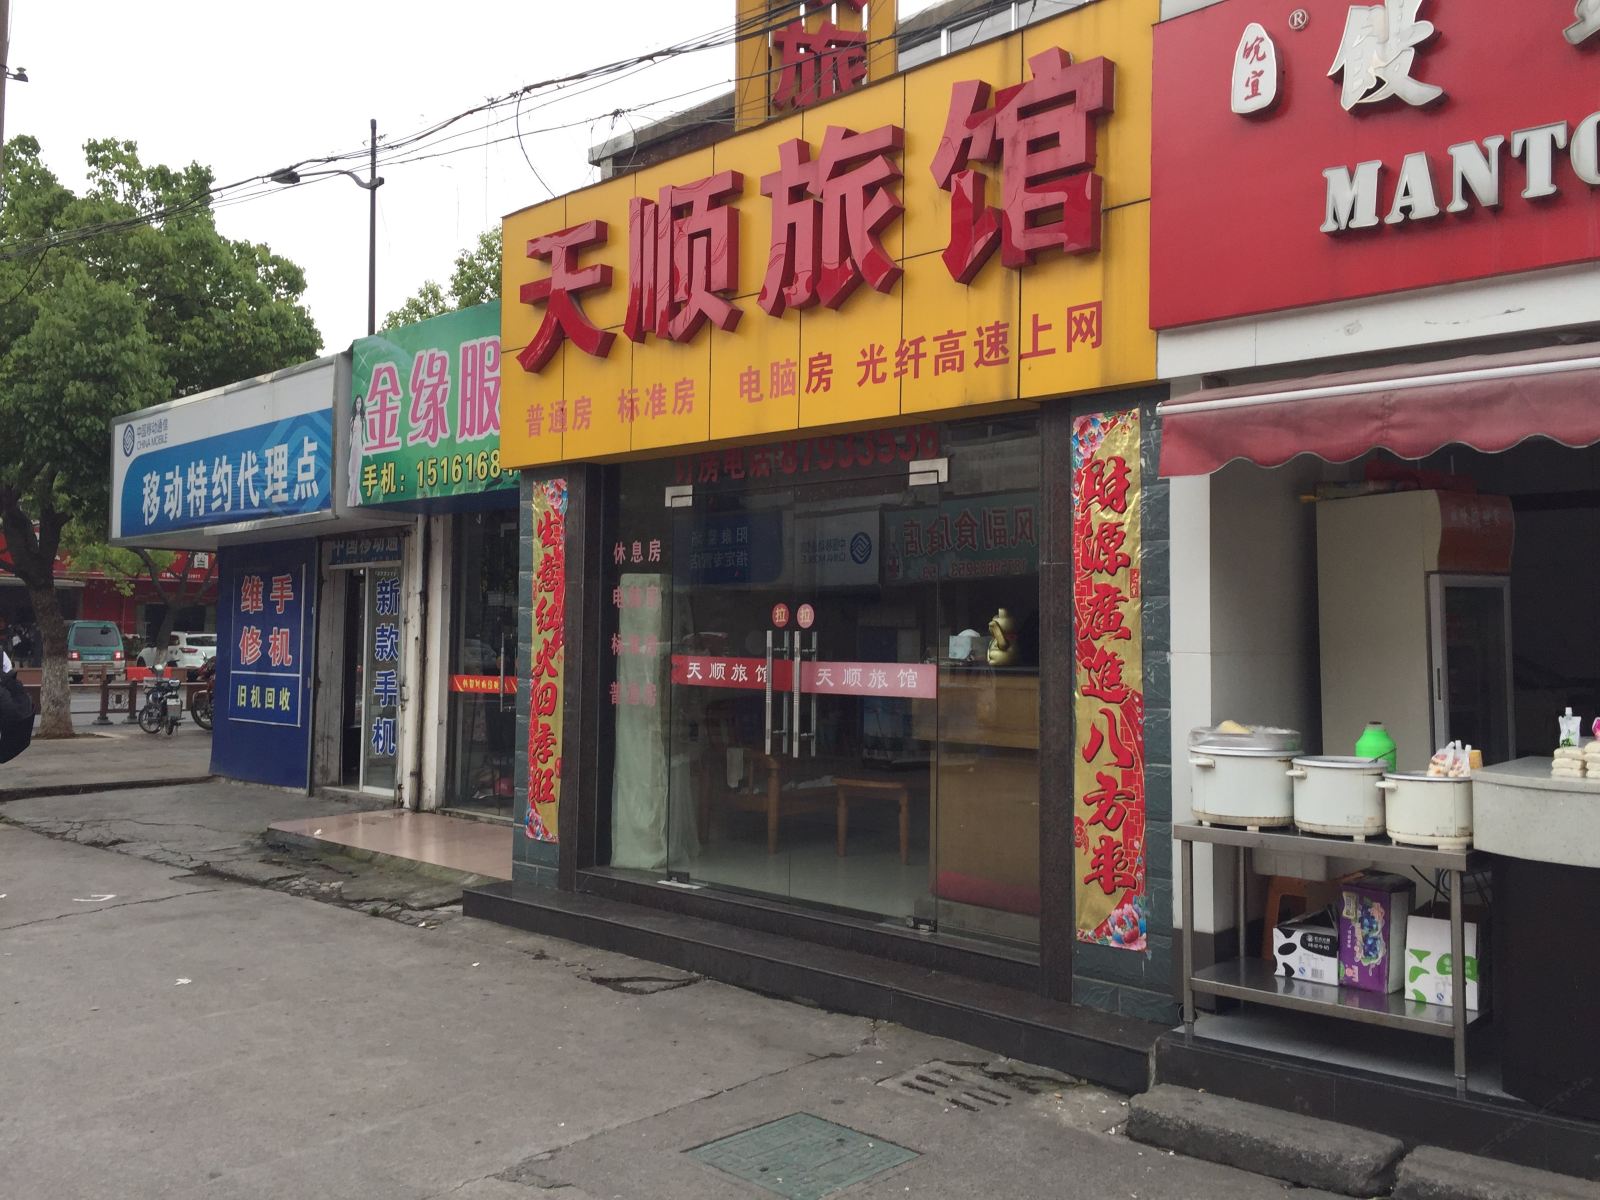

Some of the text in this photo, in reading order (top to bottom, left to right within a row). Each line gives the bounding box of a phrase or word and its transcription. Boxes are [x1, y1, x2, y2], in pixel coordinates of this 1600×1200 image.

[772, 0, 868, 110] 旅
[516, 46, 1115, 374] 天顺旅馆
[363, 338, 500, 453] 金缘服
[525, 301, 1103, 439] 普通房 标准房 电脑房 光纤高速上网
[142, 437, 319, 526] 移动特约代理点
[362, 448, 513, 497] 手机：1516168
[613, 539, 662, 565] 休息房
[237, 685, 291, 711] 旧机回收
[371, 578, 400, 756] 新款手机
[816, 668, 918, 689] 天顺旅馆
